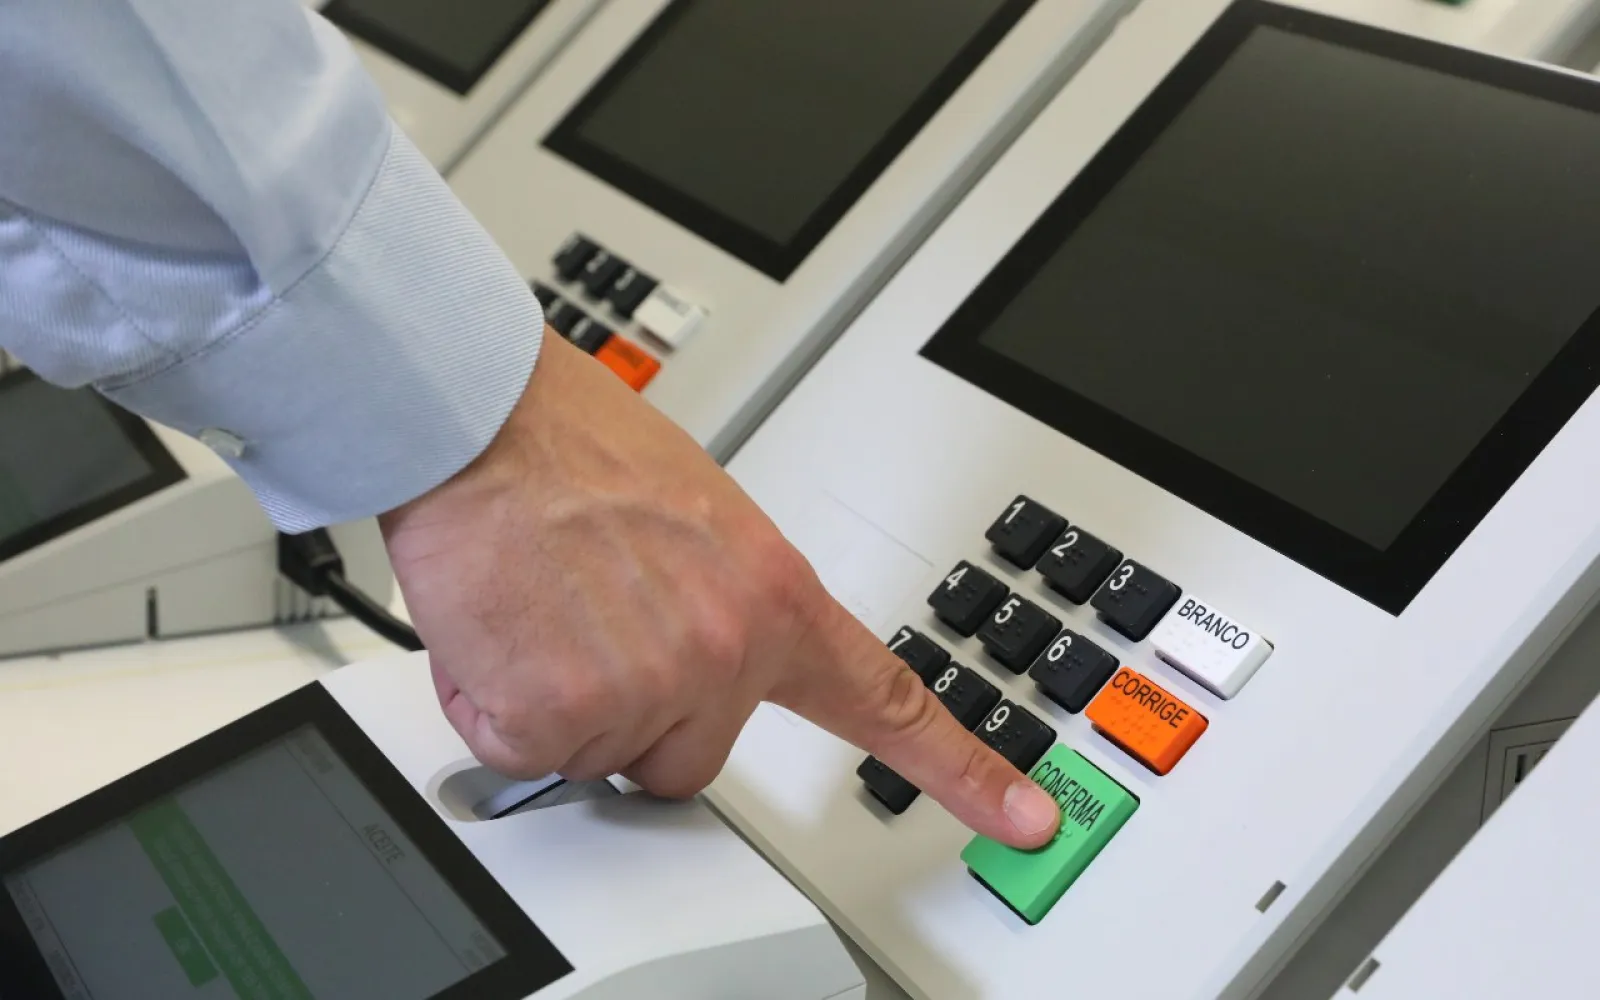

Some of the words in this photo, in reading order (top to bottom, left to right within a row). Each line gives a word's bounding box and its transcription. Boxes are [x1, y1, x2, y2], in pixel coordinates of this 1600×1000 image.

[1005, 501, 1026, 524] 1
[1051, 531, 1079, 558] 2
[946, 567, 968, 590] 4
[1109, 565, 1135, 590] 3
[994, 598, 1021, 624] 5
[1177, 598, 1250, 650] BRANCO
[890, 629, 912, 651] 7
[1047, 636, 1072, 662] 6
[934, 667, 959, 693] 8
[1111, 670, 1189, 729] CORRIGE
[985, 706, 1010, 732] 9
[1030, 760, 1106, 832] CONFIRMA
